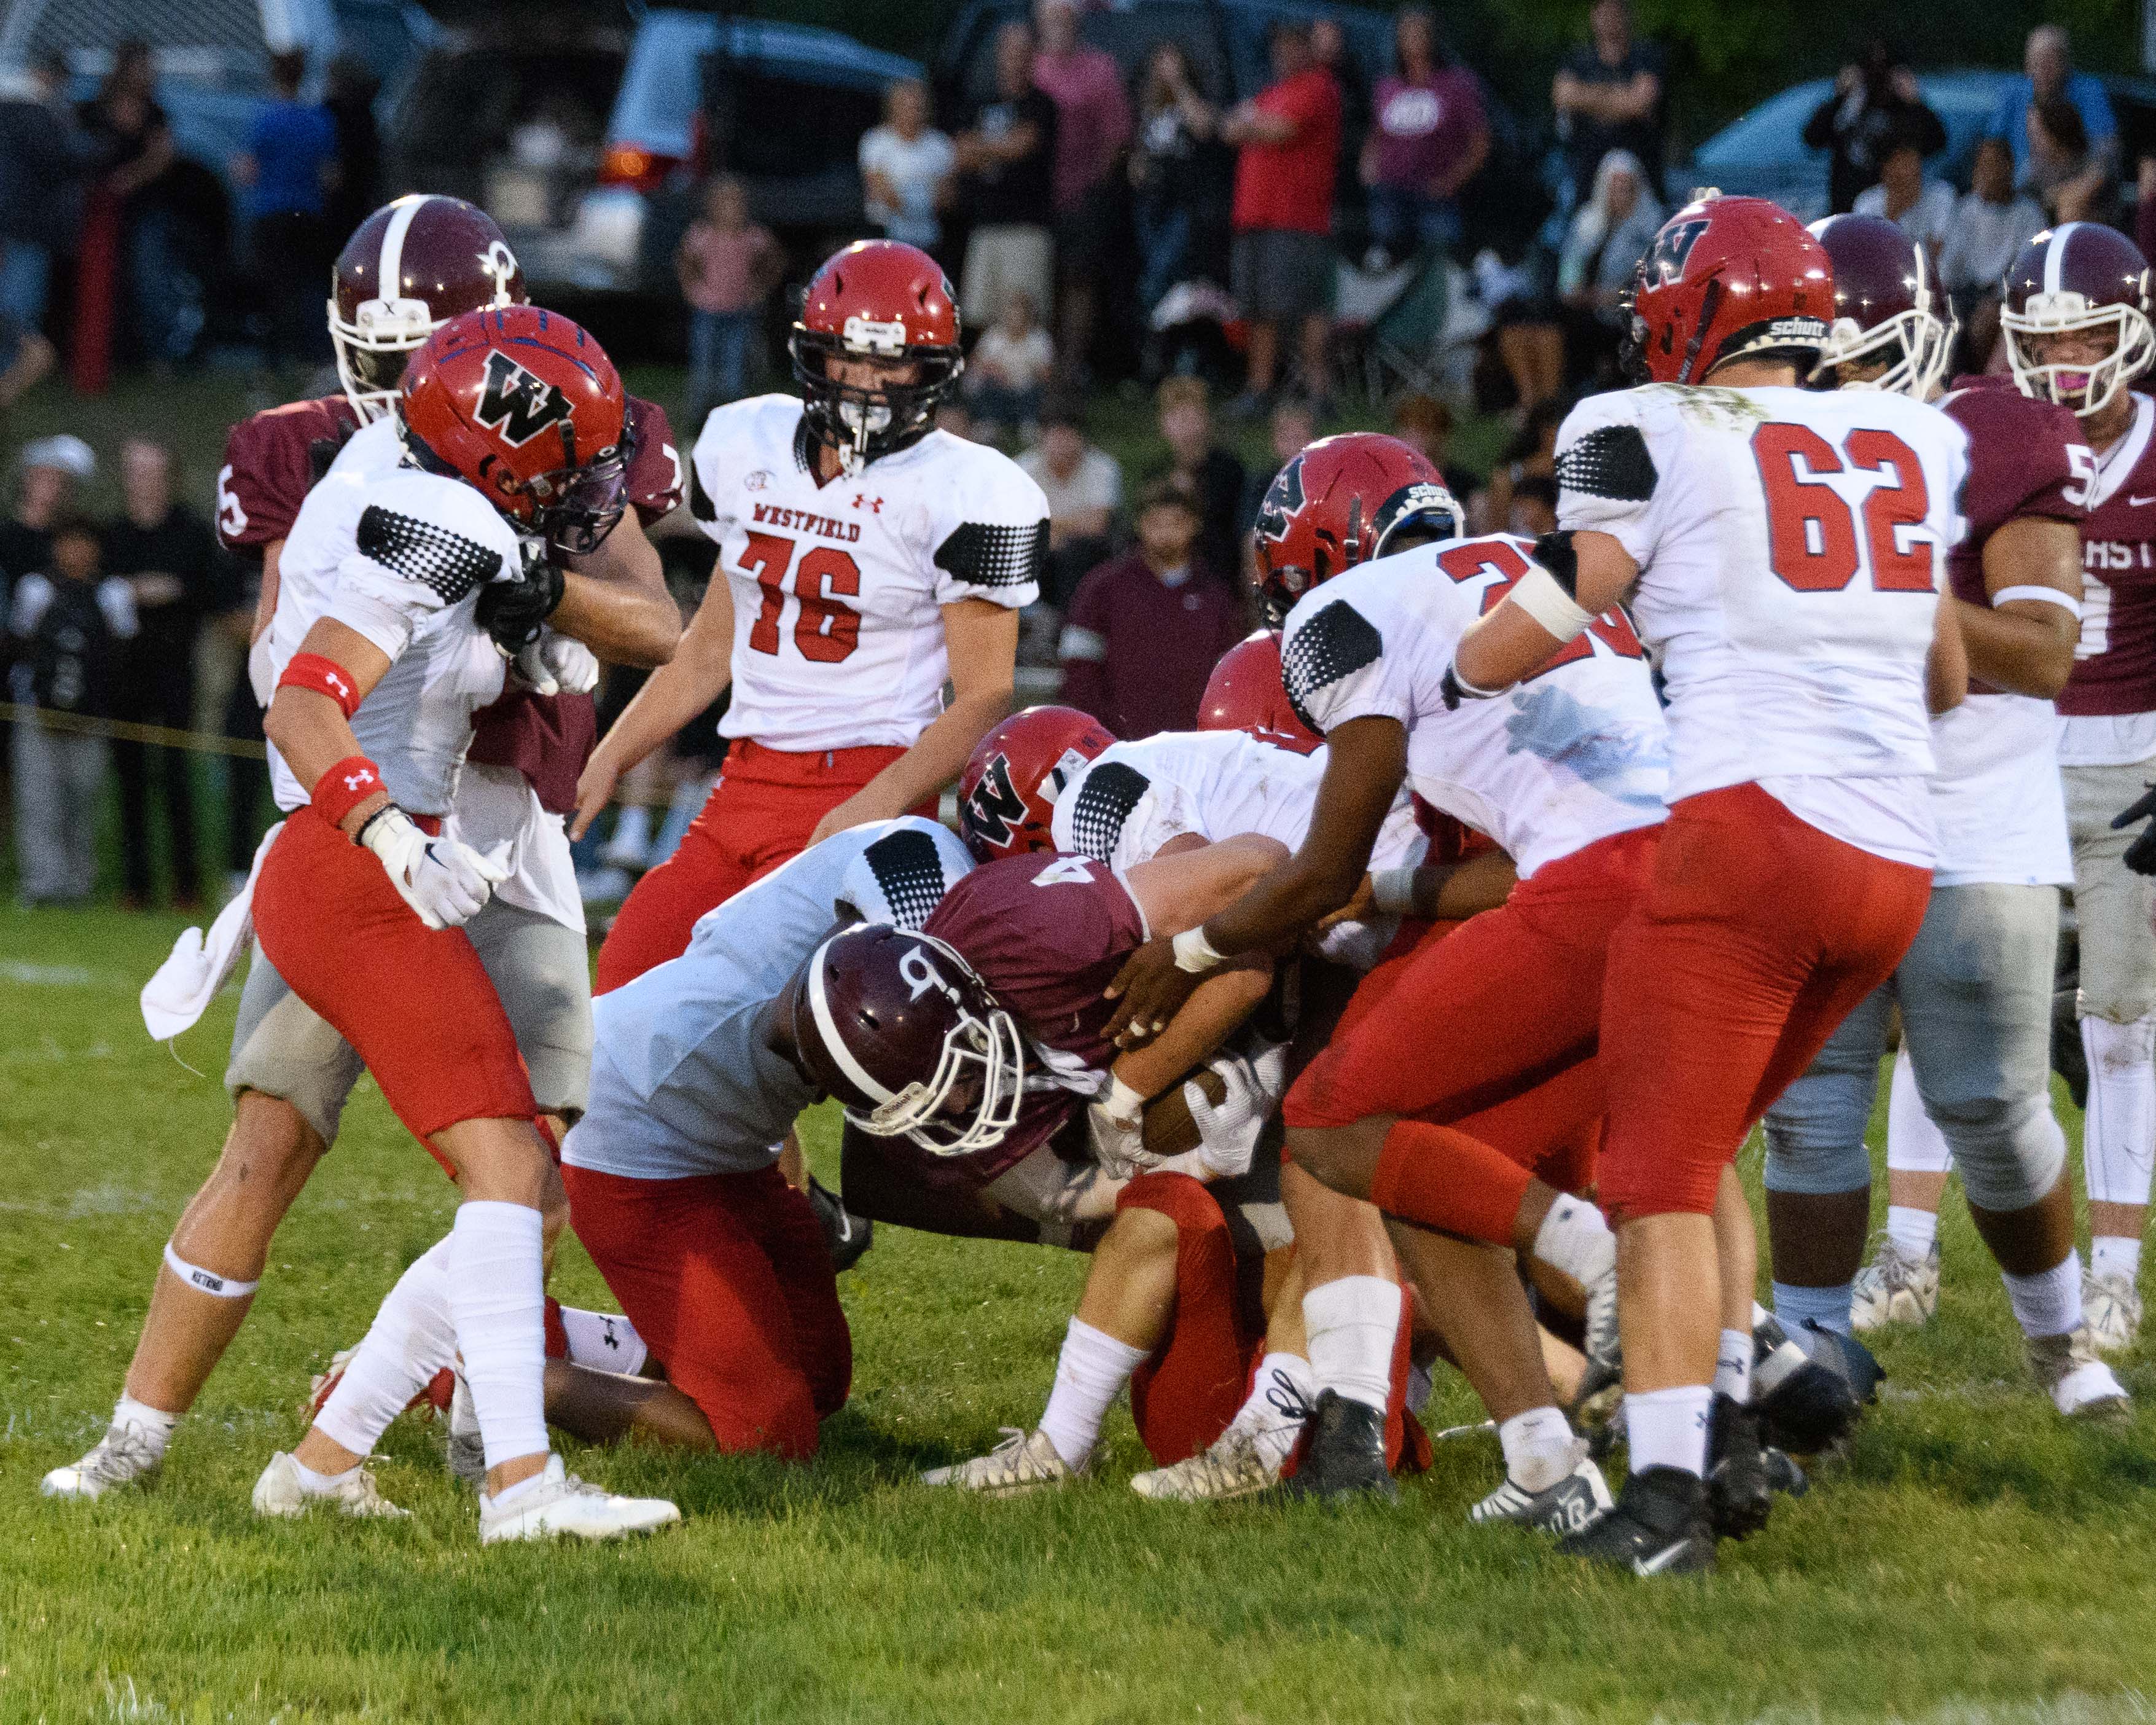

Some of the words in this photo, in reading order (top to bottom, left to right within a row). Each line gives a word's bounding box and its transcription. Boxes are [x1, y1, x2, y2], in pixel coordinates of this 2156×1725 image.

[472, 348, 576, 448] W
[753, 502, 861, 542] WESTFIELD
[1749, 422, 1939, 593] 62
[737, 529, 861, 663] 76
[965, 752, 1029, 848] W
